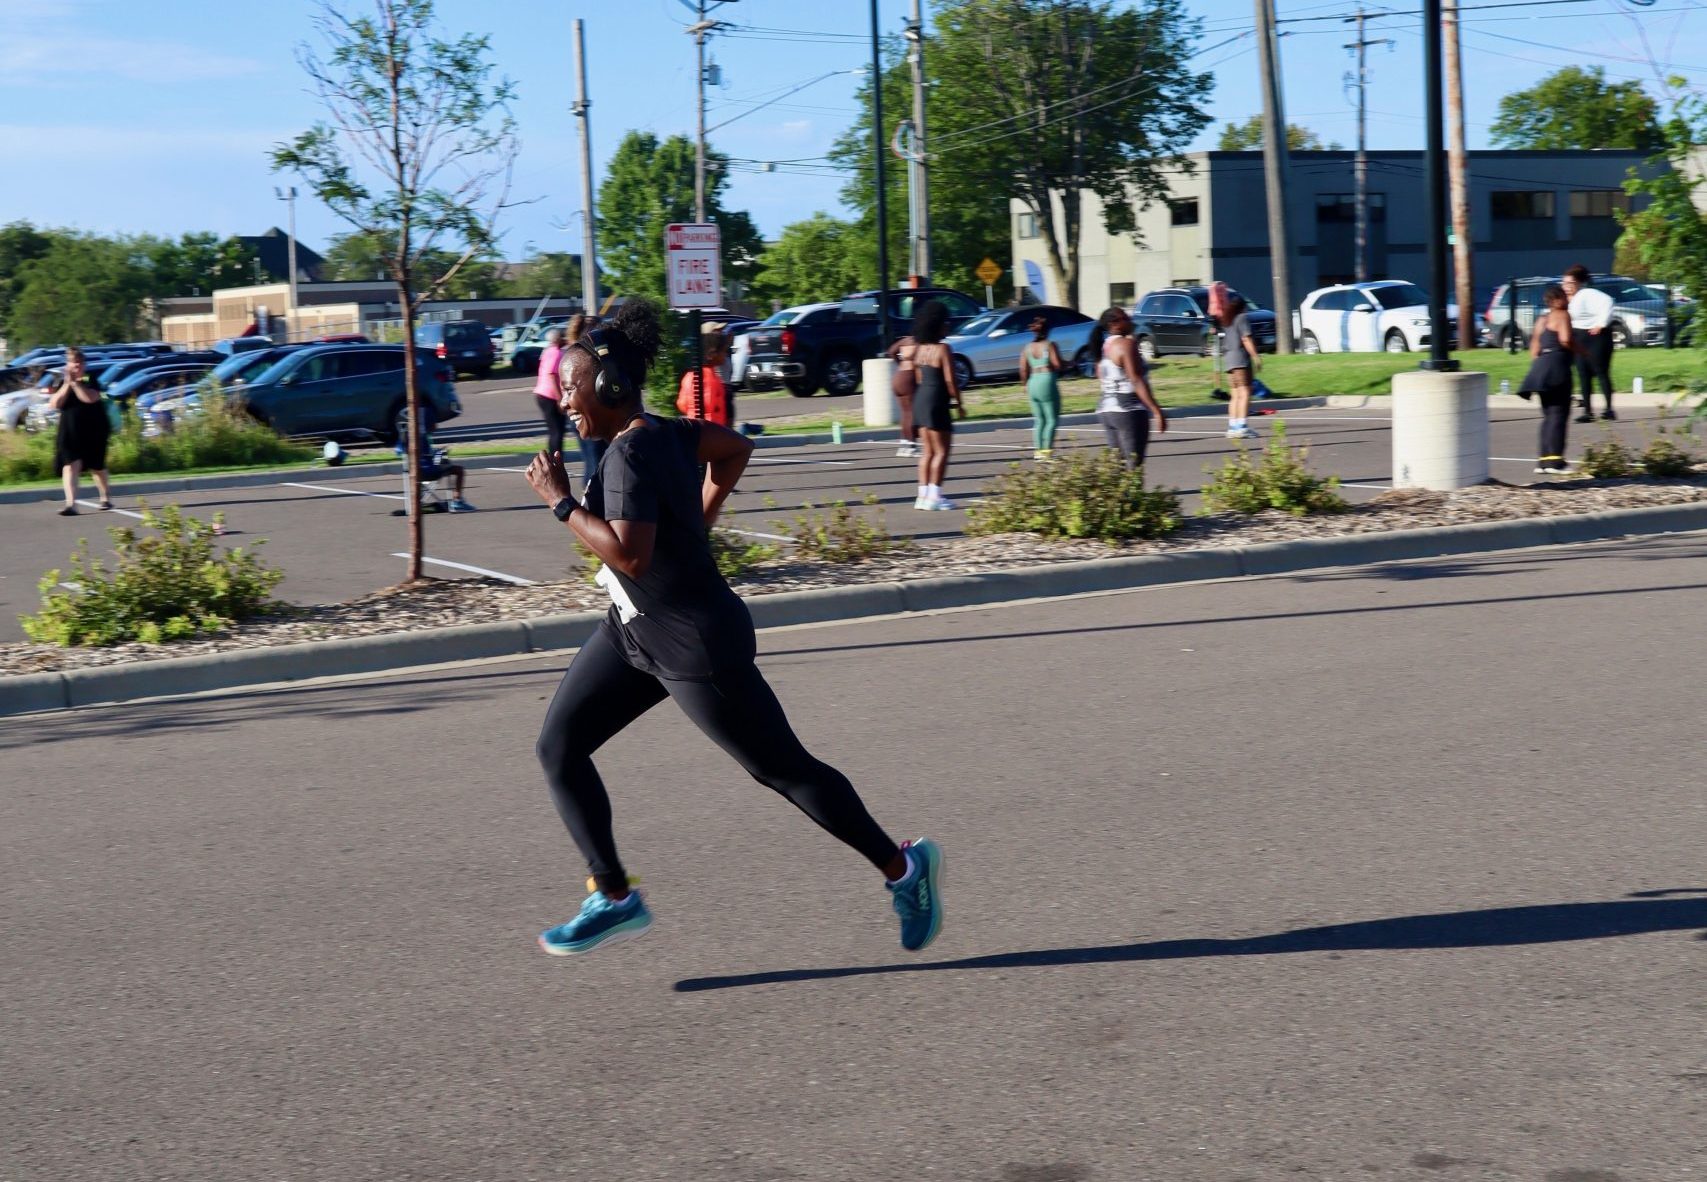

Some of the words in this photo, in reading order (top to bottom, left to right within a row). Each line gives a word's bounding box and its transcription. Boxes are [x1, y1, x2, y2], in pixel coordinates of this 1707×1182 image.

[678, 259, 710, 275] FIRE
[676, 278, 713, 295] LANE
[918, 877, 931, 910] HOKA
